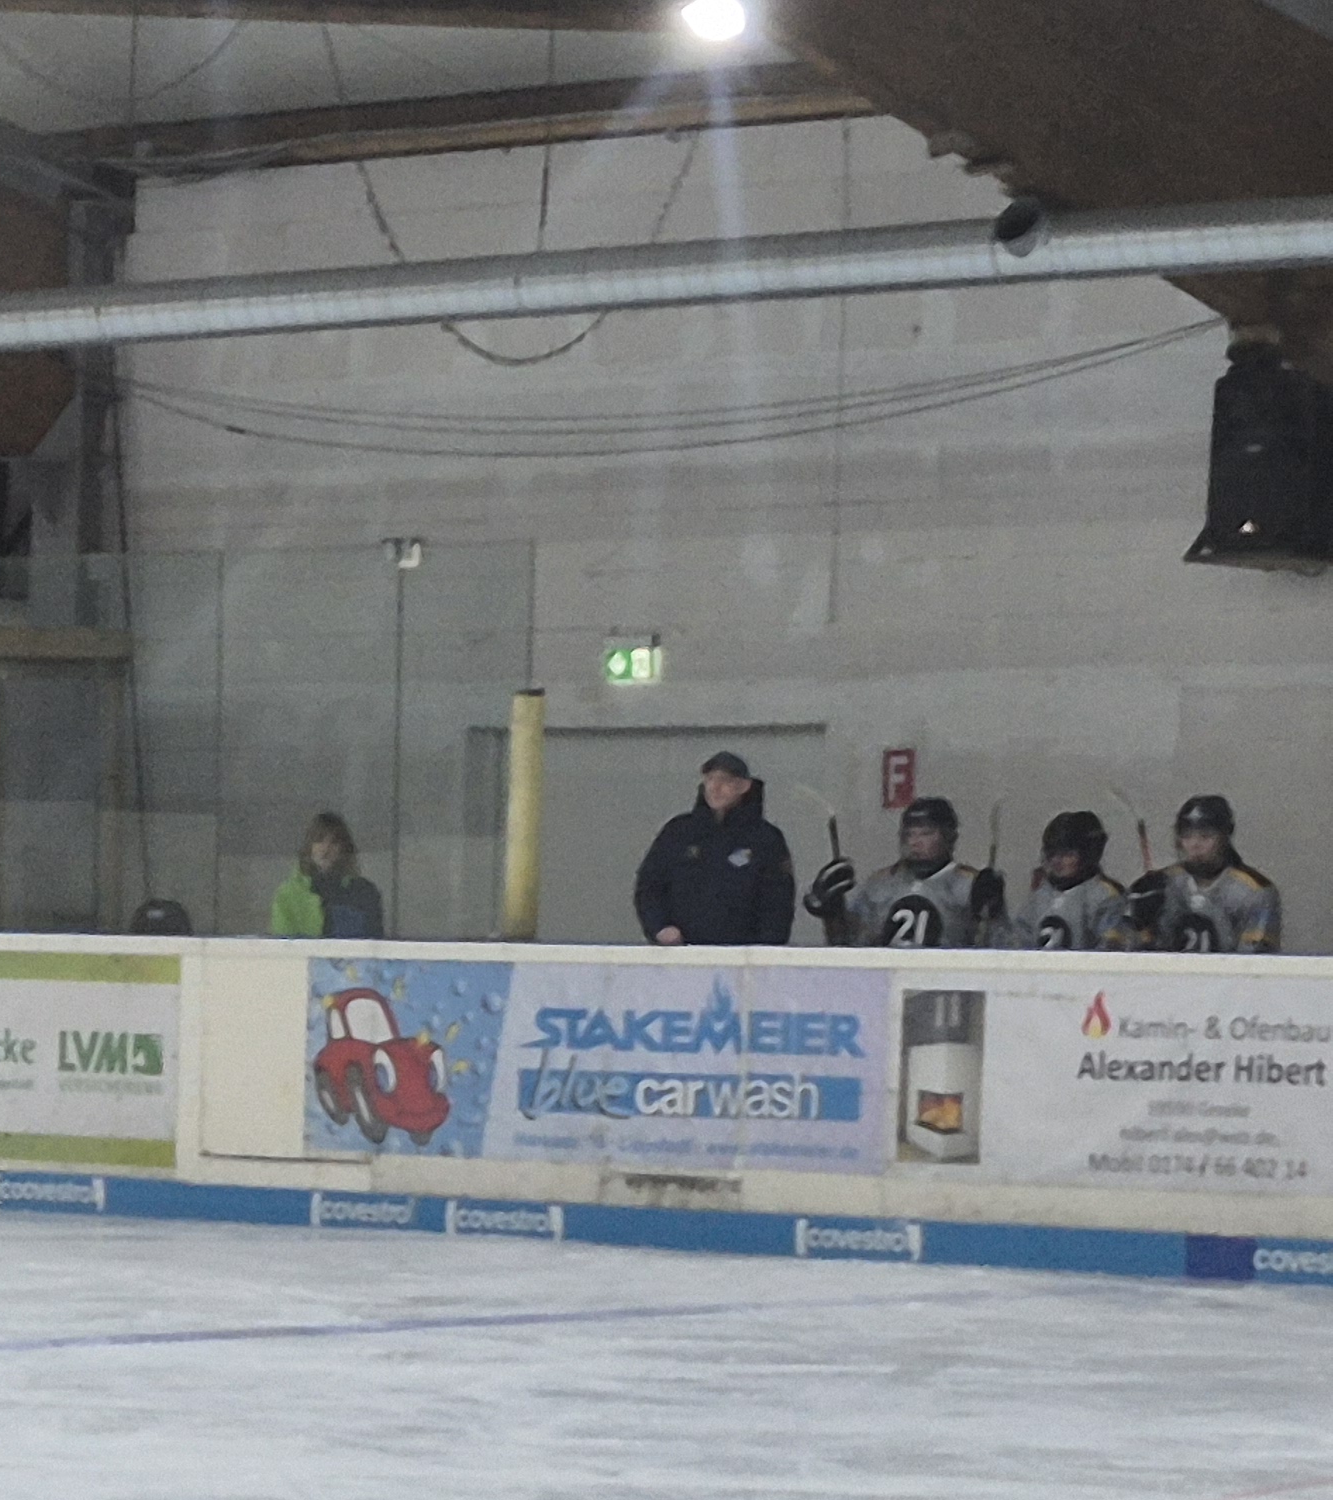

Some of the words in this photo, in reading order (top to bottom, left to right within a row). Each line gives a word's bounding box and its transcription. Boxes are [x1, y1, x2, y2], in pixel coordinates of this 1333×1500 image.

[891, 908, 929, 946] 21
[520, 1006, 867, 1059] STAKEMEIER
[1203, 1014, 1222, 1040] &
[1229, 1015, 1332, 1043] Ofenbau
[57, 1029, 130, 1075] LVM
[1076, 1050, 1227, 1083] Alexander
[1233, 1053, 1327, 1087] Hibert
[520, 1046, 634, 1120] blue
